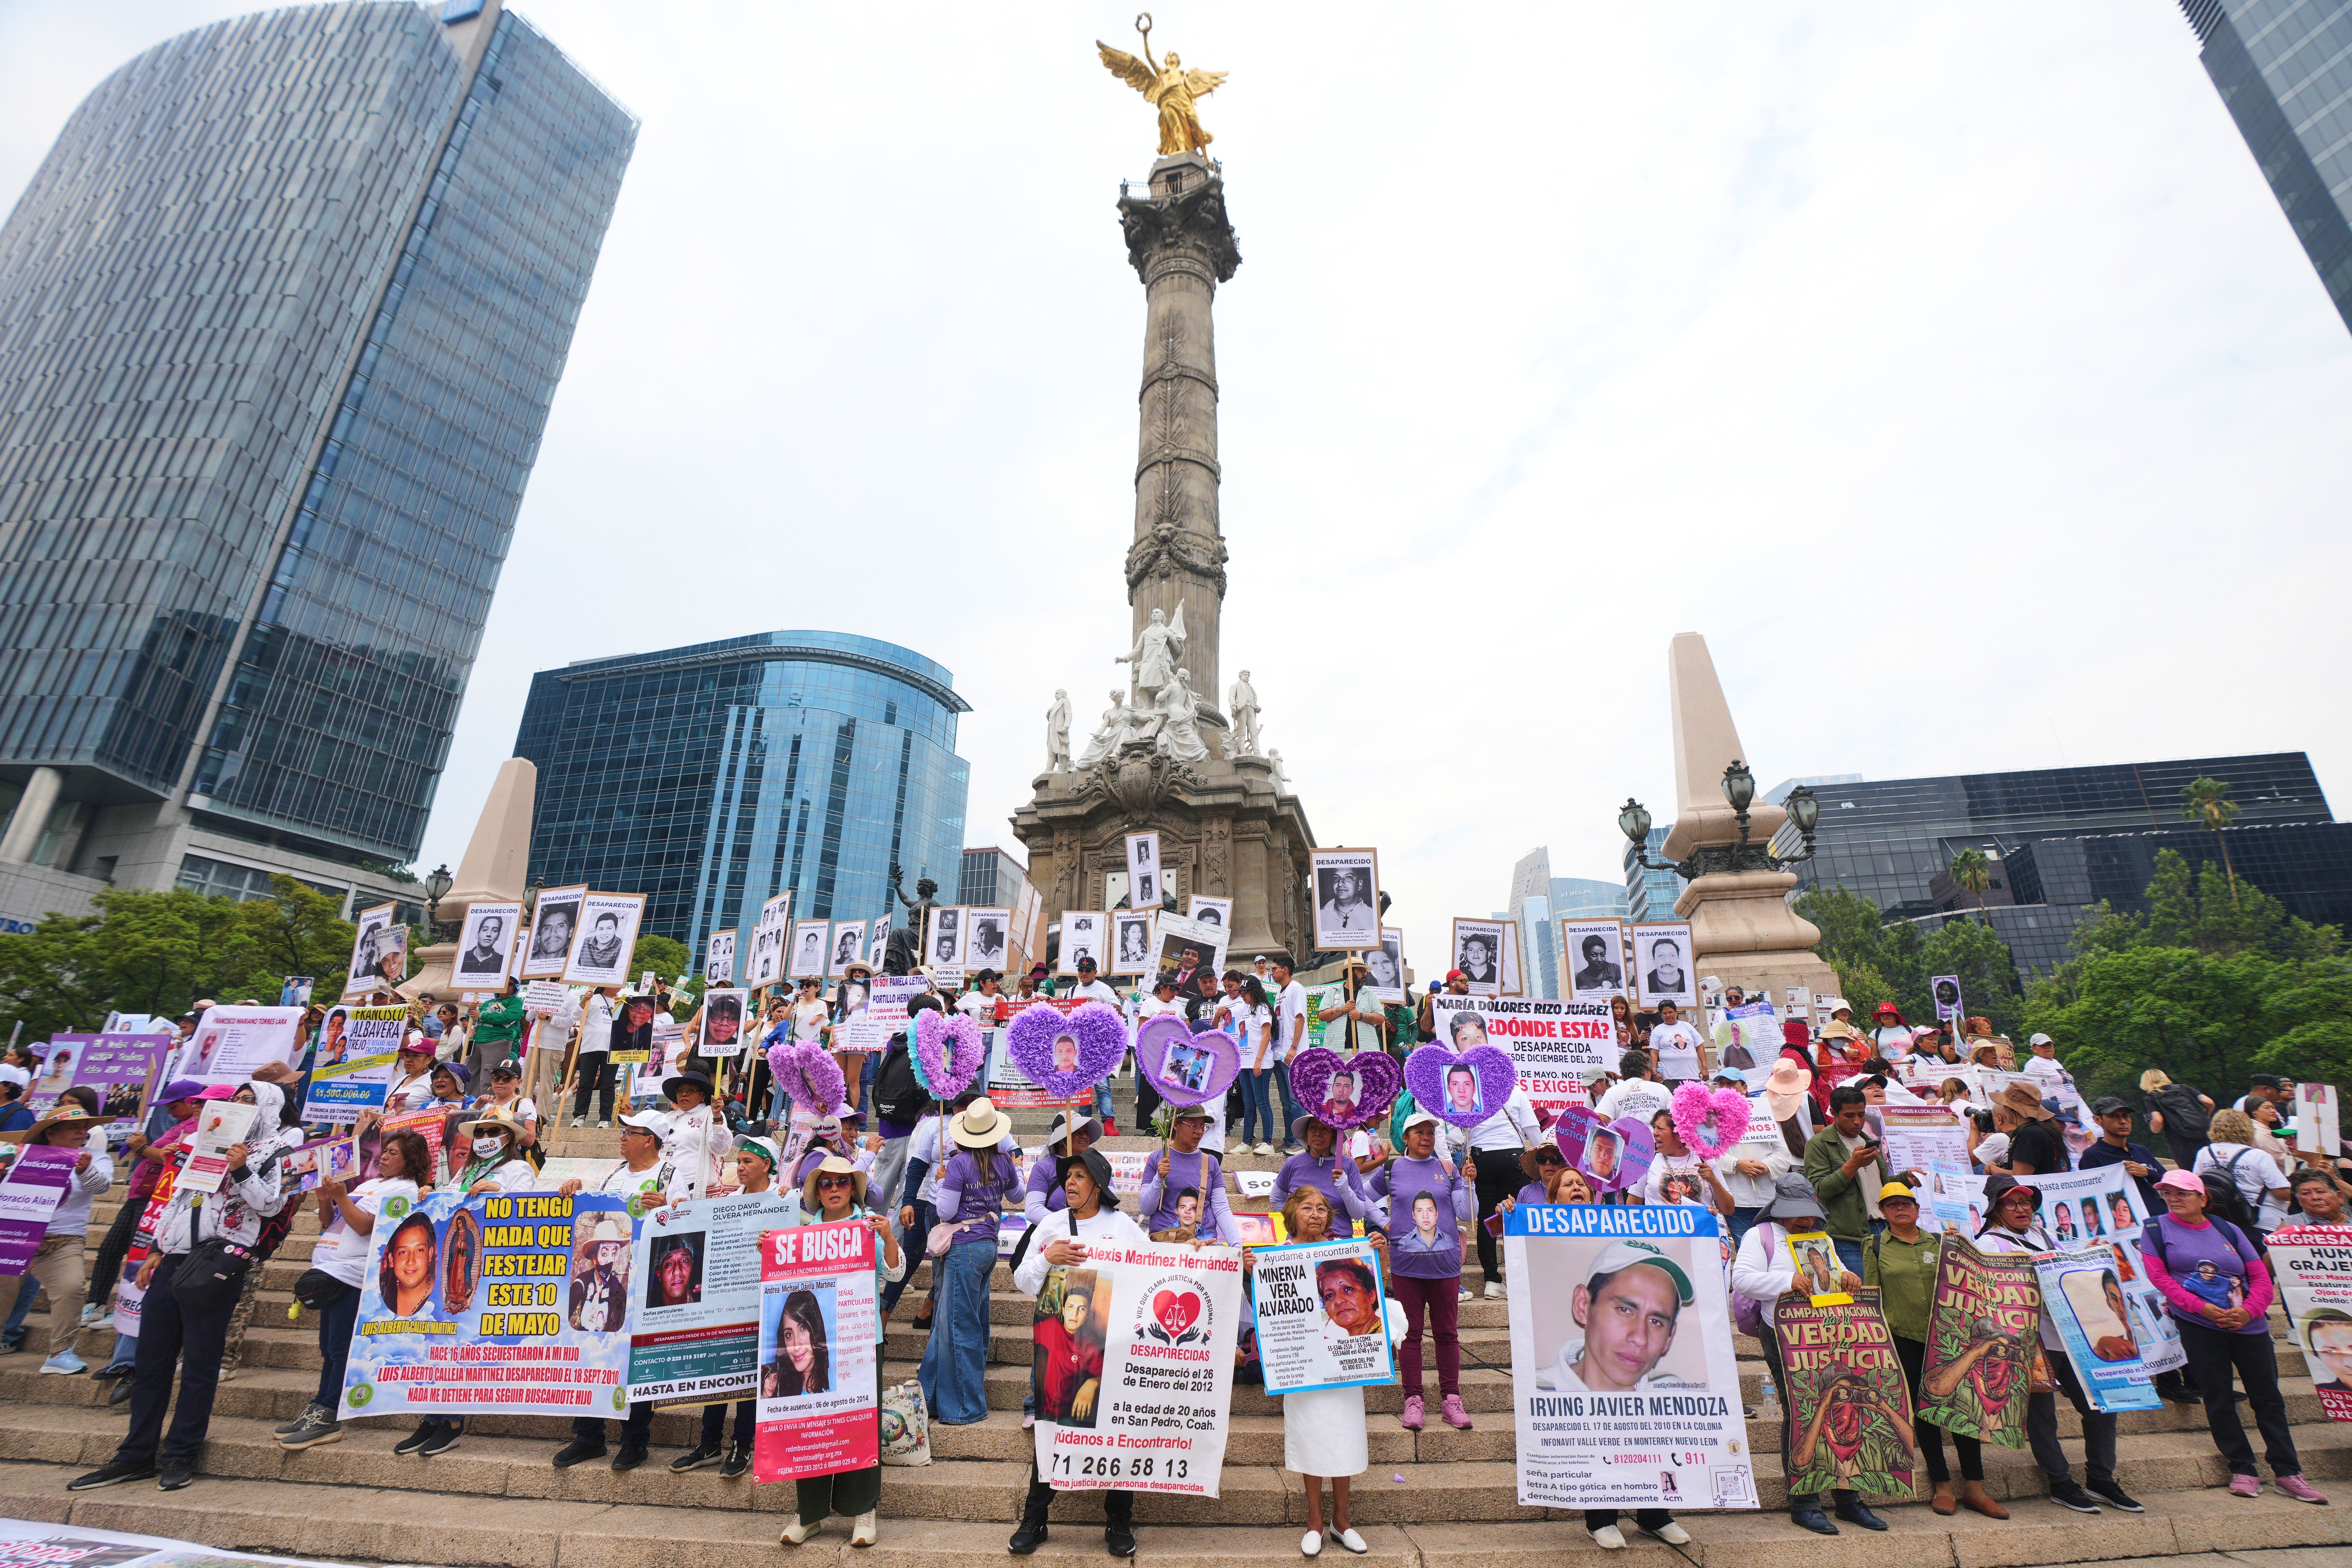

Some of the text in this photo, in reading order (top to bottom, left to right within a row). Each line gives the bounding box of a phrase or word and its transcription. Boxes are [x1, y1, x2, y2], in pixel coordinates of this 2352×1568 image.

[362, 912, 390, 922] DESAPARECIDO
[1179, 932, 1201, 941] Guadalupe
[872, 979, 879, 988] YO
[890, 977, 908, 986] PAMELA
[872, 994, 896, 1004] PORTILLO
[1436, 998, 1609, 1016] MARÍA DOLORES RIZO JUÁREZ
[356, 1007, 406, 1021] FRANCISCO
[351, 1021, 399, 1038] ALBAVERA
[1487, 1016, 1609, 1039] ¿DÓNDE ESTÁ?
[348, 1039, 366, 1050] TREJO
[365, 1047, 396, 1055] ENCONTRARTE
[1513, 1041, 1592, 1054] DESAPARECIDA
[1527, 1054, 1603, 1064] DICIEMBRE DEL 2012
[1564, 1110, 1592, 1127] VERDAD
[1630, 1141, 1650, 1156] PARA
[19, 1159, 48, 1168] Justicia
[1624, 1151, 1651, 1168] GONZO
[2039, 1182, 2060, 1191] hasta
[32, 1196, 55, 1206] Alain
[485, 1196, 573, 1219] NO TENGO
[713, 1202, 761, 1214] DIEGO DAVID
[743, 1206, 789, 1218] HERNÁNDEZ
[1528, 1207, 1695, 1234] DESAPARECIDO
[482, 1226, 572, 1248] NADA QUE
[775, 1227, 862, 1265] SE BUSCA
[1087, 1249, 1238, 1272] Alexis Martínez Hernández
[1264, 1251, 1303, 1265] Ayudame
[1313, 1246, 1359, 1258] encontrarla
[484, 1255, 567, 1277] FESTEJAR
[1258, 1264, 1306, 1283] MINERVA
[1947, 1250, 2037, 1284] CAMPAÑA NACIONAL
[782, 1284, 799, 1292] Michael
[801, 1282, 814, 1291] Dávila
[816, 1280, 836, 1289] Martínez
[1270, 1282, 1298, 1299] VERA
[1946, 1264, 2040, 1308] VERDAD
[488, 1284, 557, 1306] ESTE 10
[1259, 1297, 1314, 1317] ALVARADO
[1836, 1307, 1880, 1317] NACIONAL
[1939, 1289, 2038, 1331] JUSTICIA
[480, 1313, 560, 1336] DE MAYO
[1780, 1323, 1888, 1345] VERDAD
[430, 1344, 579, 1362] HACE 16 AÑOS SECUESTRARON A MI HIJO
[1788, 1349, 1898, 1372] JUSTICIA
[1530, 1397, 1729, 1417] IRVING JAVIER MENDOZA
[1614, 1454, 1661, 1464] 8120204111
[1686, 1452, 1706, 1465] 911
